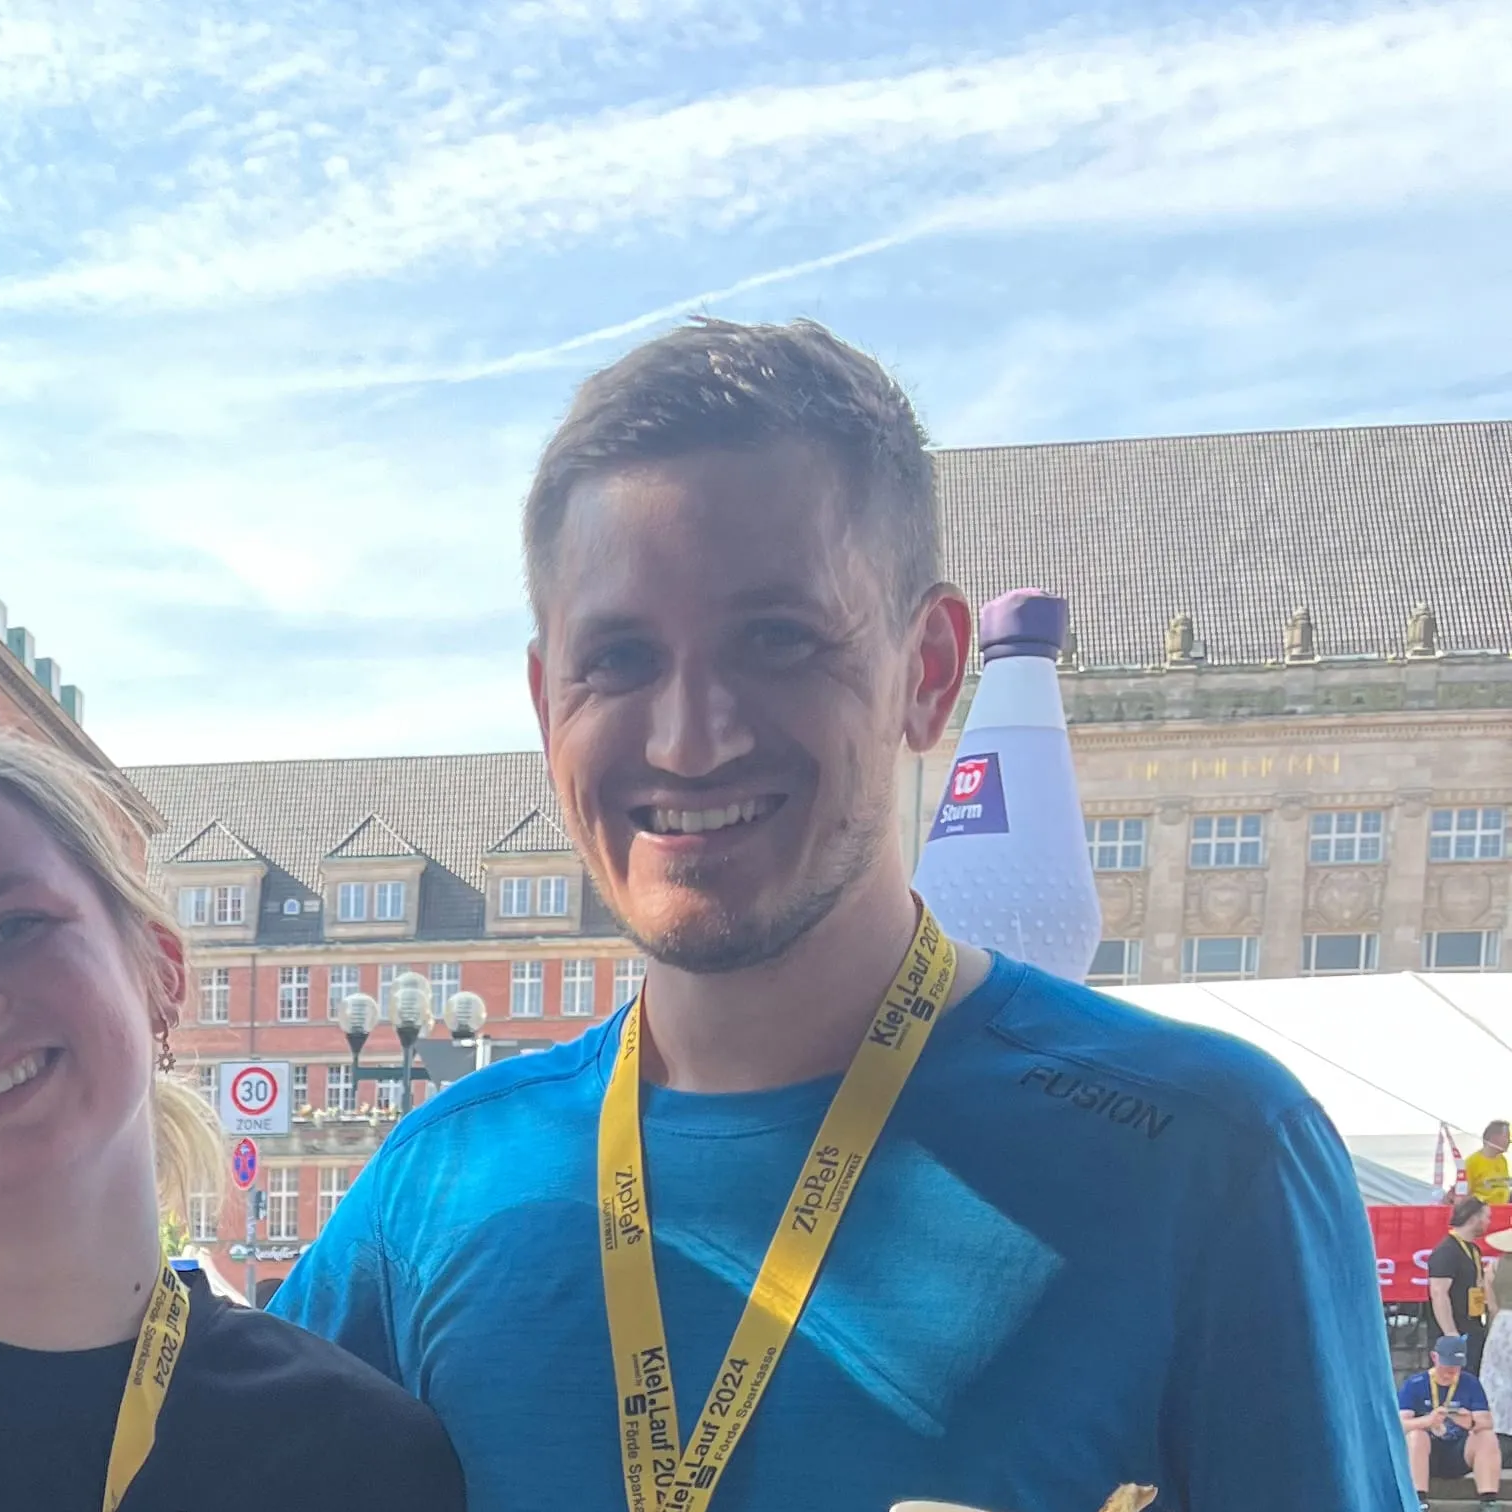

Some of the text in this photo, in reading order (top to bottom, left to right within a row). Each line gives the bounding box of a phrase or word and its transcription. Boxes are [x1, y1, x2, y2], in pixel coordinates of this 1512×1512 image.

[241, 1080, 268, 1103] 30
[1020, 1065, 1175, 1141] FUSION
[236, 1118, 273, 1131] ZONE
[152, 1334, 178, 1389] 2024
[709, 1357, 750, 1418] 2024
[715, 1422, 741, 1462] Förde
[736, 1346, 777, 1418] Sparkasse
[625, 1421, 641, 1461] Förde
